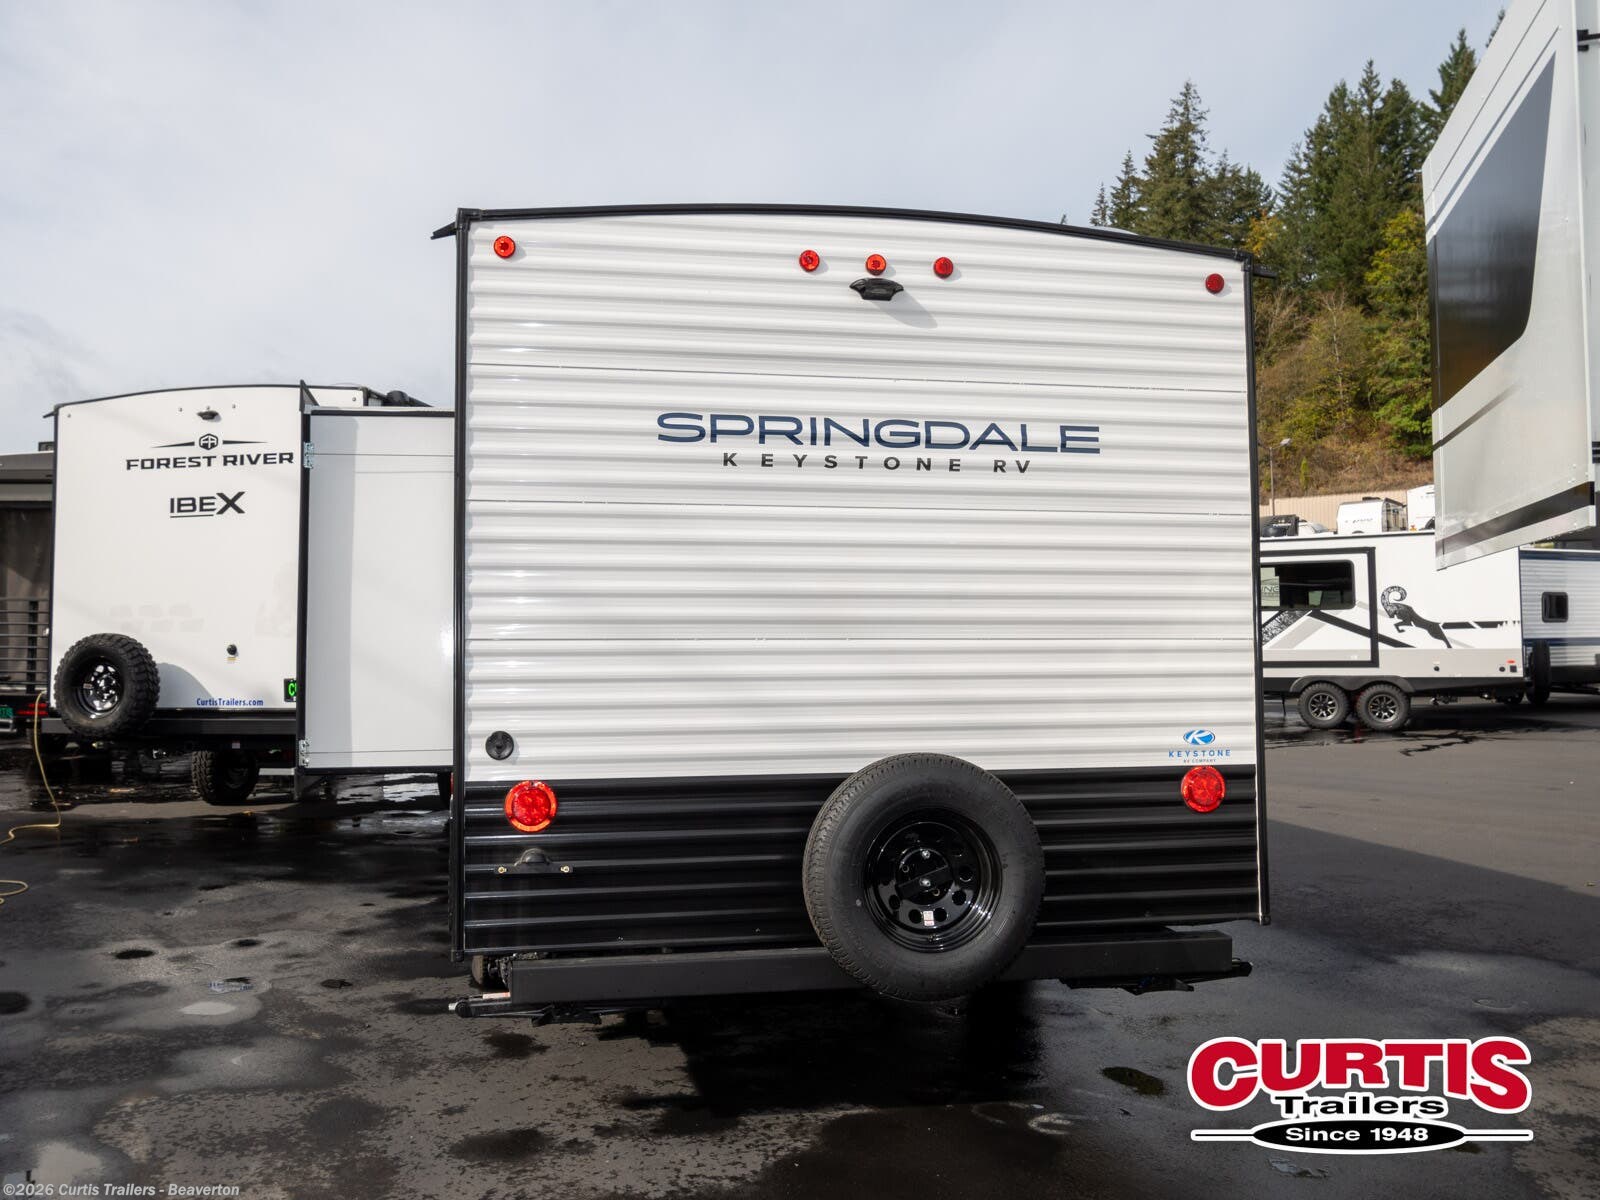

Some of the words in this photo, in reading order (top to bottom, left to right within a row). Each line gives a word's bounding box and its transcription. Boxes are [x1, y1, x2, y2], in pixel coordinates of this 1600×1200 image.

[656, 411, 1101, 454] SPRINGDALE
[126, 456, 217, 470] FOREST
[223, 452, 294, 466] RIVER
[723, 452, 962, 472] KEYSTONE
[993, 459, 1031, 474] RV
[170, 491, 245, 517] IBEX
[196, 697, 264, 706] CurtisTrailers.com
[1168, 749, 1231, 758] KEYSTONE
